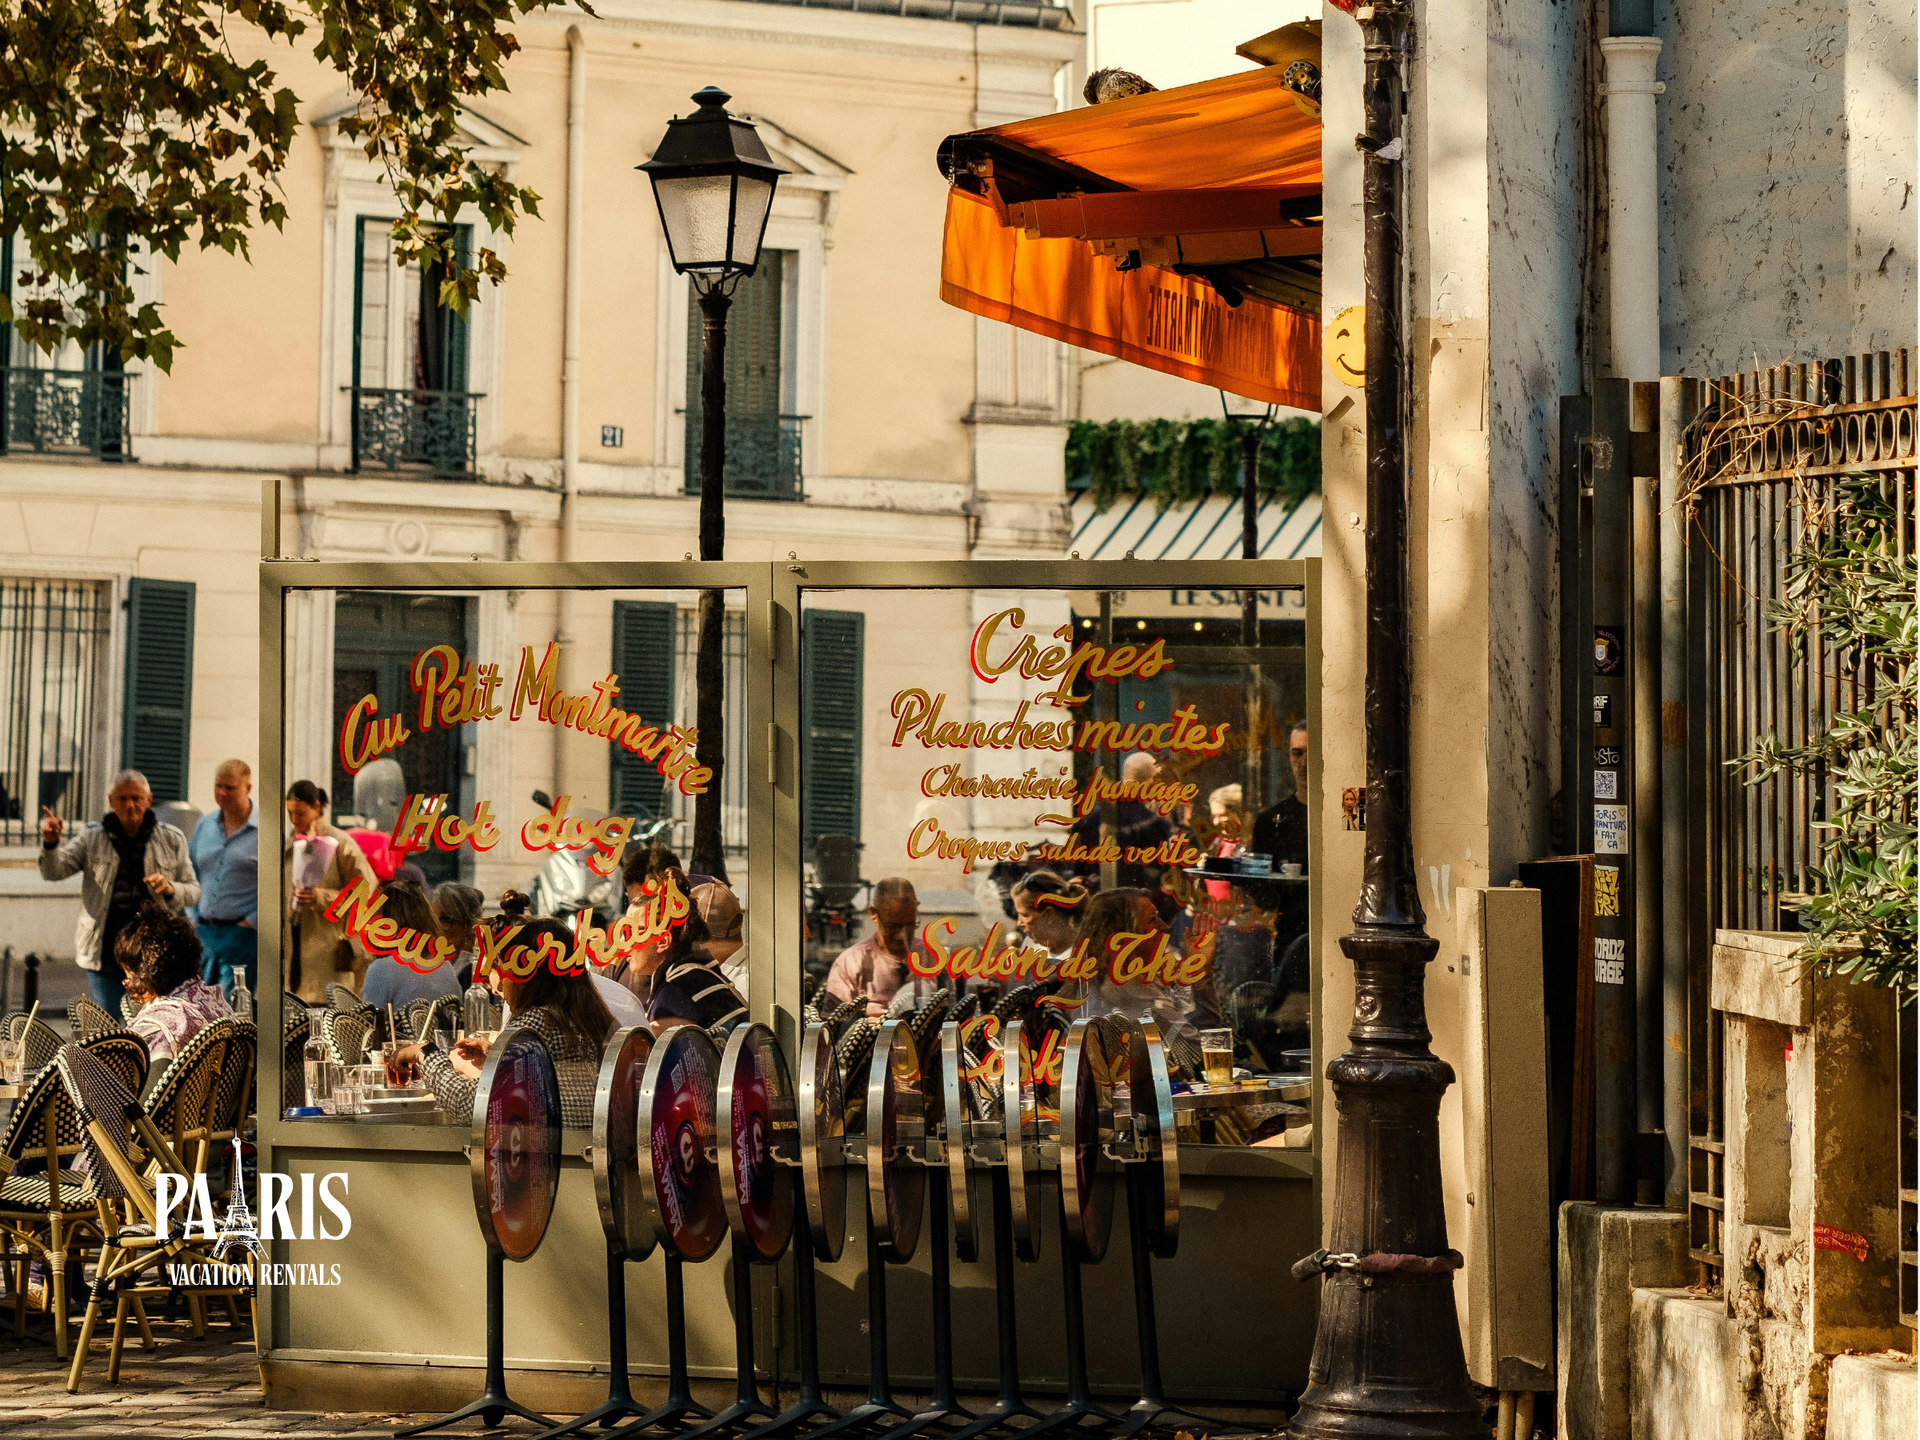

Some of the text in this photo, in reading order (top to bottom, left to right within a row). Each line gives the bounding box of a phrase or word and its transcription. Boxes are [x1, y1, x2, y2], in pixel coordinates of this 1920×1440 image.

[603, 426, 621, 447] 21
[1209, 590, 1287, 607] SANT
[970, 607, 1175, 707] Crêpes
[340, 641, 713, 796] Au Petit Montmartre
[891, 688, 1076, 750] Planches
[1072, 701, 1230, 756] mixtes
[921, 764, 1199, 819] Charcuterie, fromage
[389, 793, 636, 876] Hot dog
[907, 817, 1202, 874] Croques salade verte
[323, 874, 690, 983] New Yorkais
[907, 916, 1216, 987] Salon de Thé
[1595, 937, 1625, 961] ORDZ
